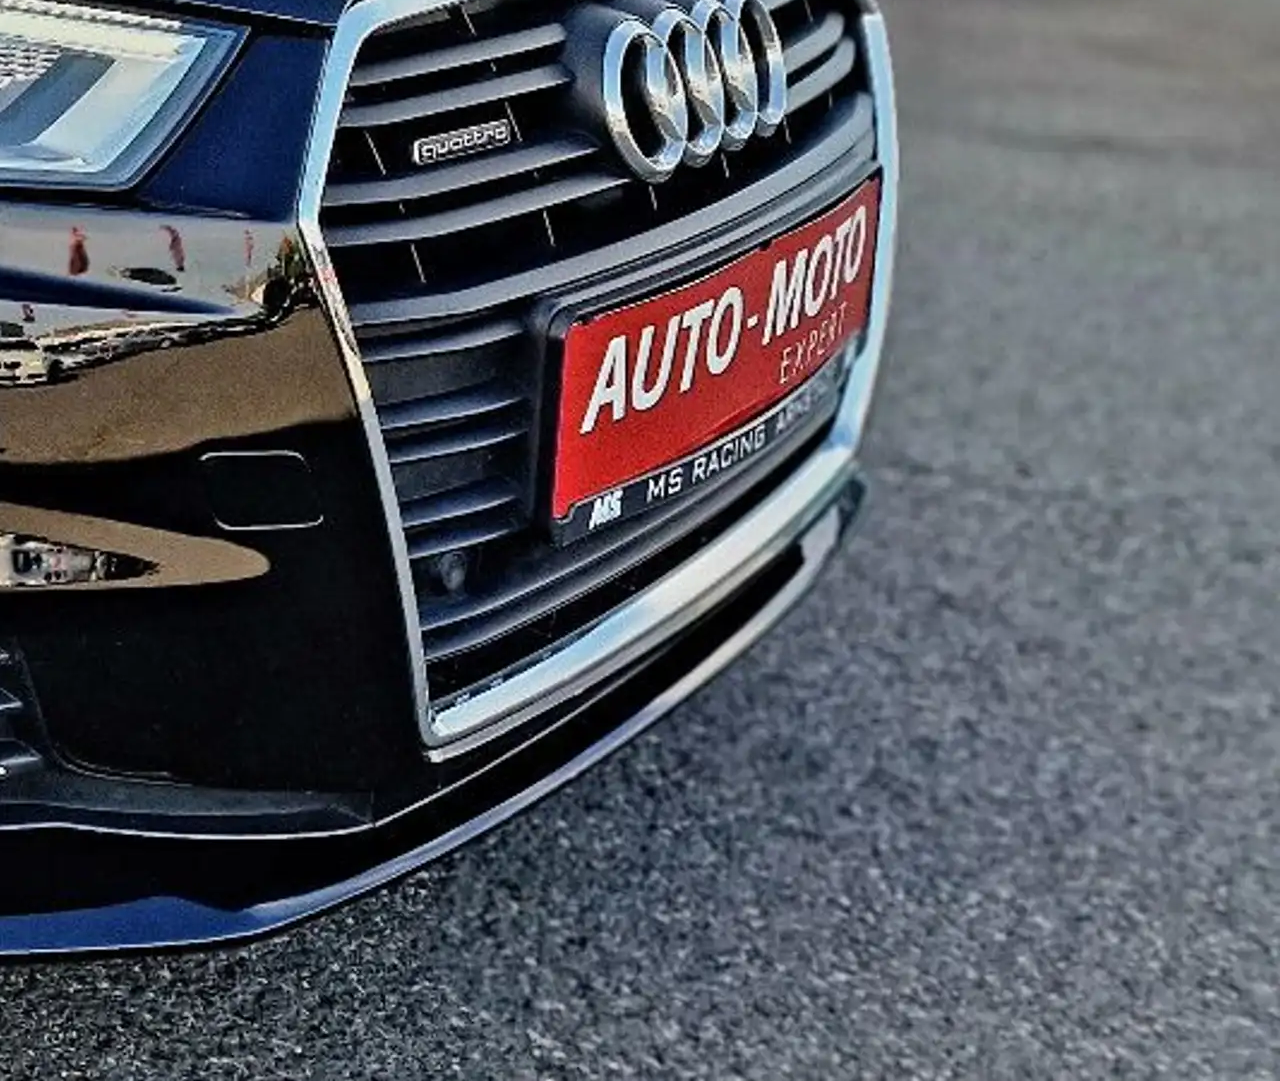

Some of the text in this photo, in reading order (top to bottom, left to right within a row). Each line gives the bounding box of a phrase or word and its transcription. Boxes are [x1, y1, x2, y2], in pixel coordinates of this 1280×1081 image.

[421, 126, 507, 159] quattro
[579, 205, 867, 435] AUTO-MOTO
[646, 465, 683, 503] MS
[691, 425, 767, 484] RACING
